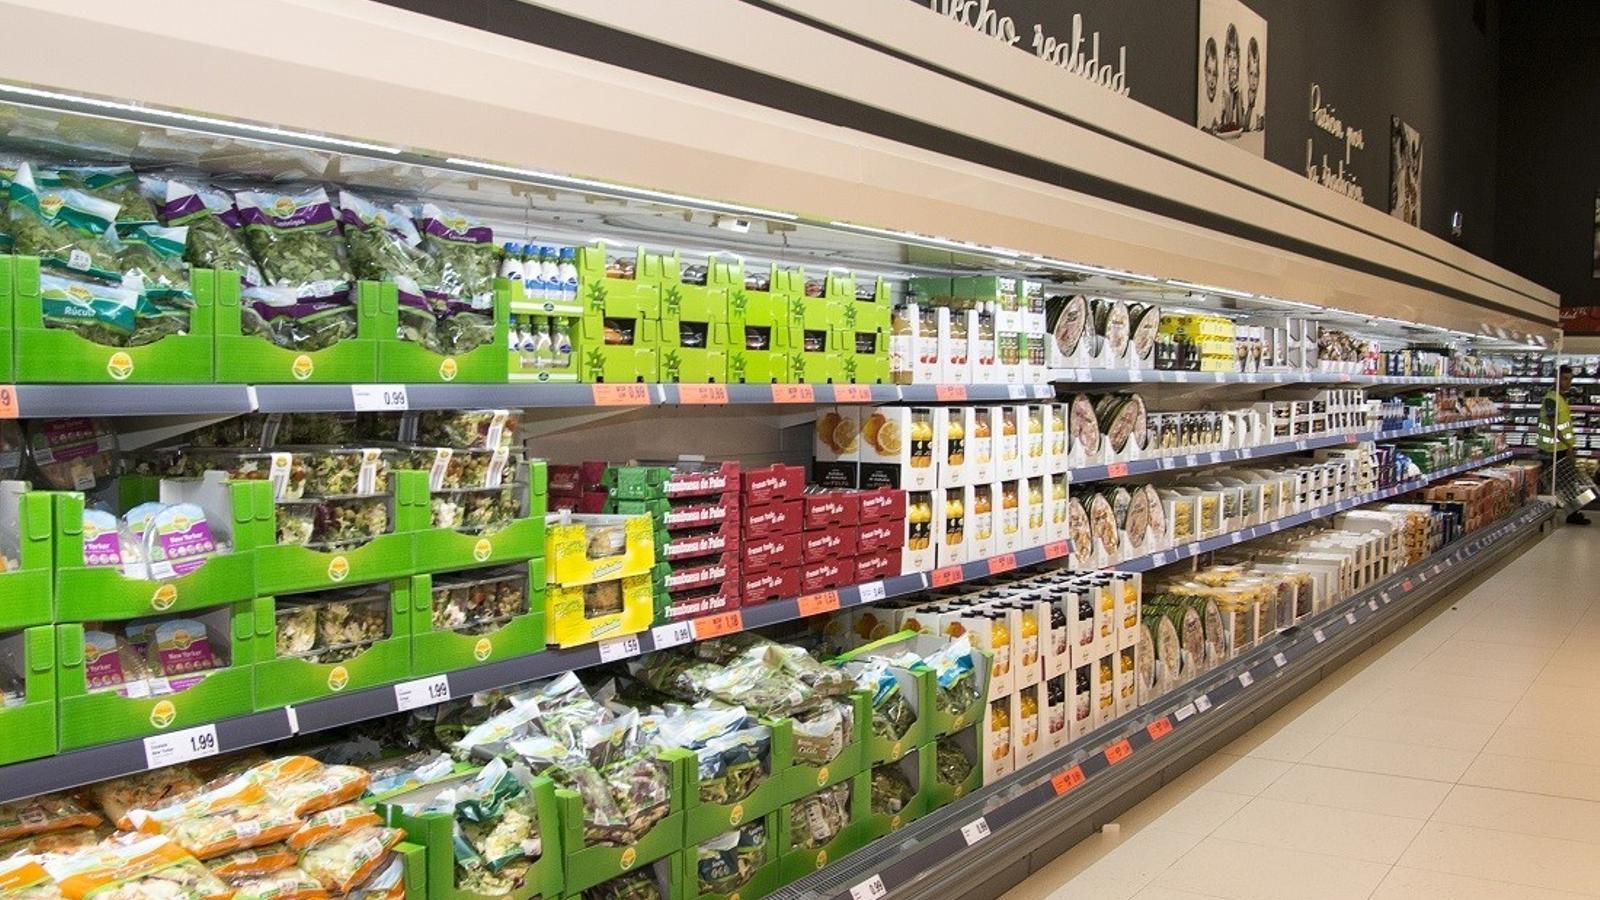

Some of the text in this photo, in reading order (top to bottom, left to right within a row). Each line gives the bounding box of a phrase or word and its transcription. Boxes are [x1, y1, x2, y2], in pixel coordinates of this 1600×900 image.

[930, 0, 1020, 46] echo
[384, 391, 405, 405] 0.99
[429, 682, 447, 698] 1.99
[191, 733, 214, 752] 1.99
